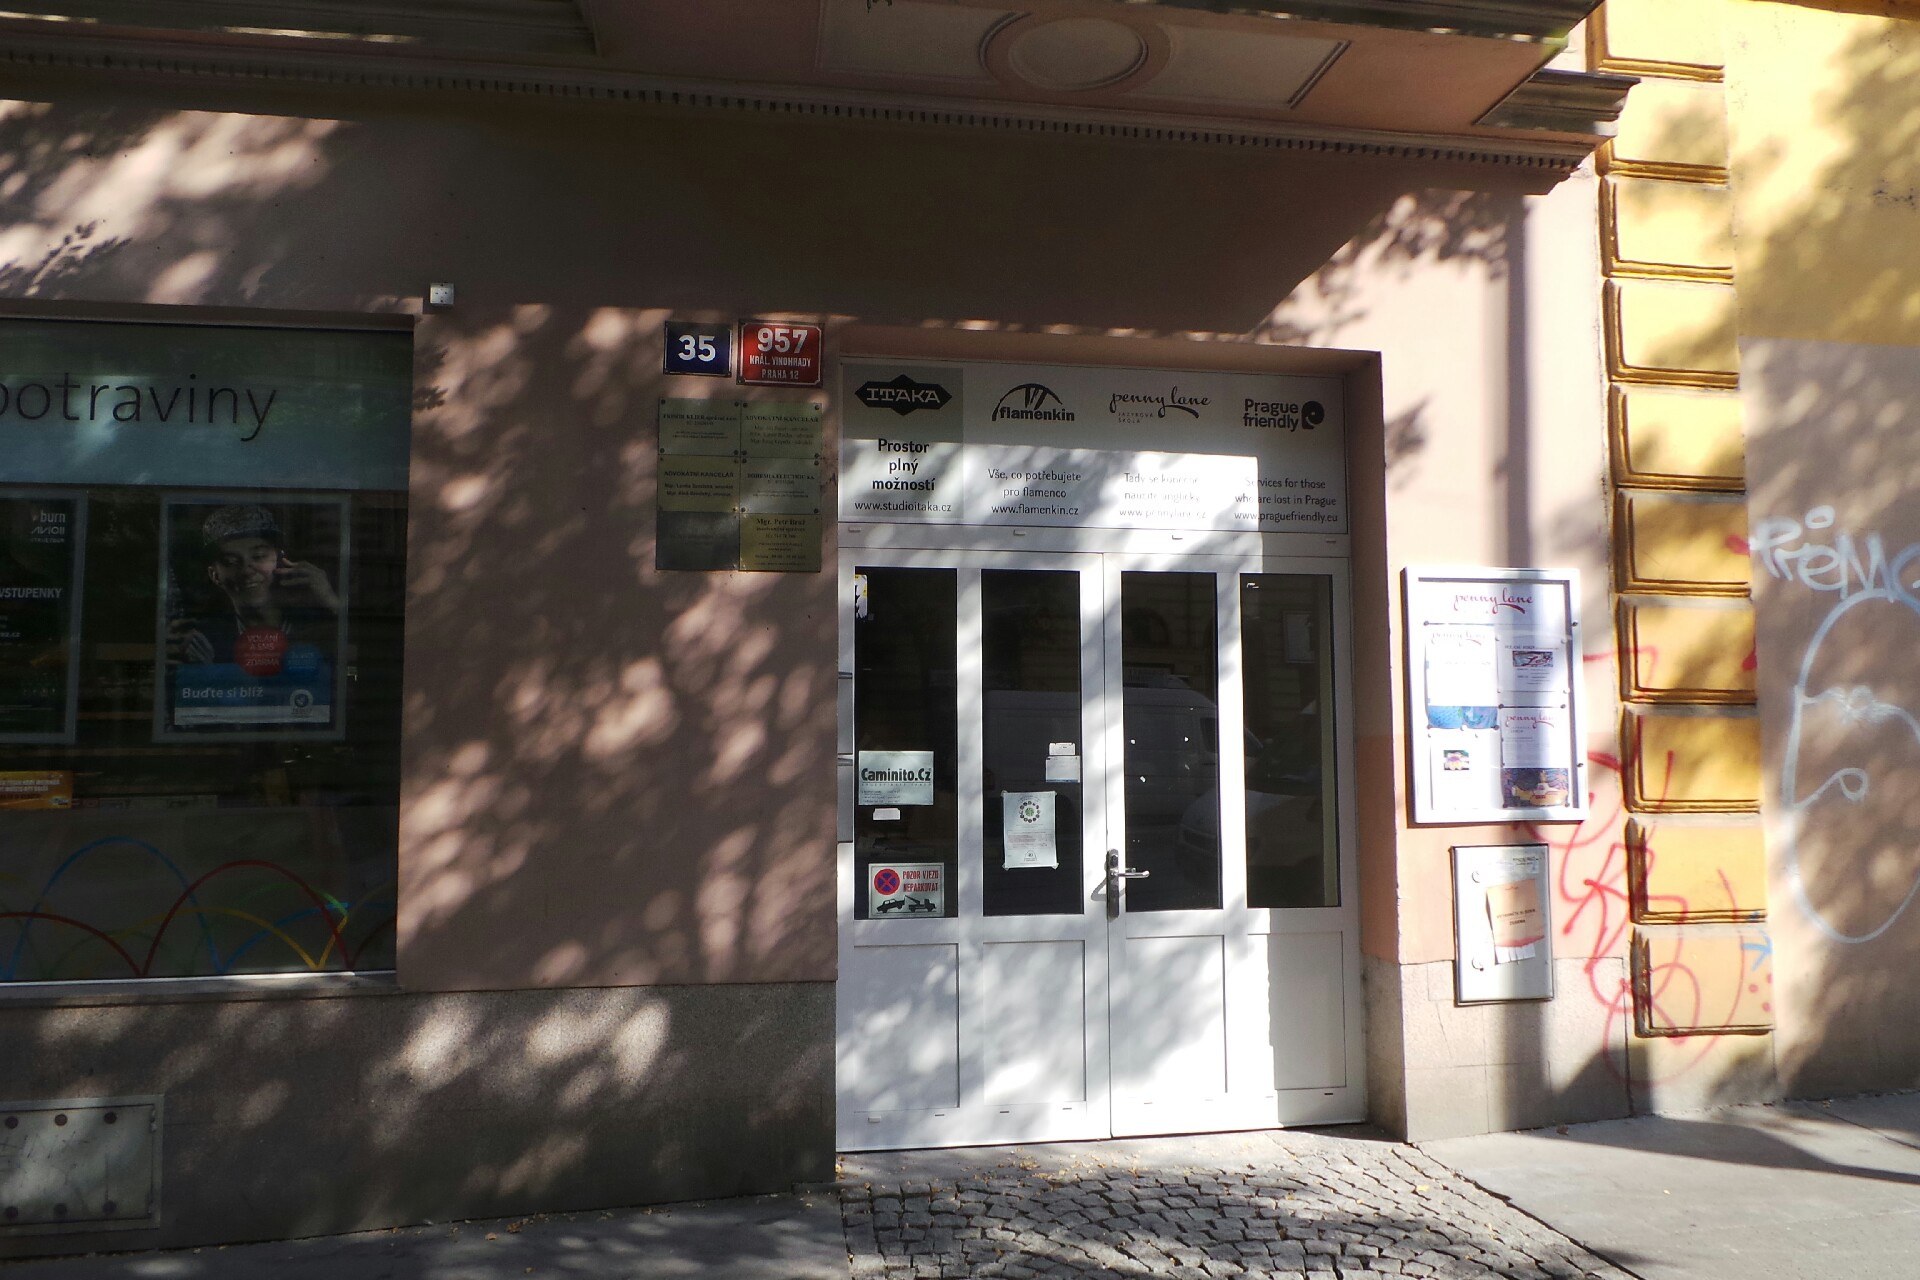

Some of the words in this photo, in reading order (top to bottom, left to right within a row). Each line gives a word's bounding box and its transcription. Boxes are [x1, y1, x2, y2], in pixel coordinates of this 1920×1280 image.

[757, 327, 808, 354] 957
[677, 334, 717, 363] 35
[749, 352, 770, 366] KRÁL.
[772, 355, 811, 368] VINOHRADY
[761, 368, 787, 379] PRAHA
[789, 370, 799, 380] 12
[866, 387, 941, 404] ITAKA
[1109, 392, 1166, 418] penny
[1171, 385, 1211, 406] lane
[0, 372, 277, 442] otraviny
[999, 406, 1075, 421] flamenkin
[1244, 398, 1299, 417] Prague
[1243, 412, 1299, 432] friendly
[878, 438, 930, 453] Prostor
[889, 457, 919, 475] plný
[872, 476, 936, 491] možností
[987, 468, 1008, 480] Vše,
[1011, 471, 1022, 480] co
[1025, 470, 1082, 484] potřebujete
[1124, 472, 1145, 486] Tady
[1245, 476, 1283, 488] Services
[1284, 477, 1298, 488] for
[1300, 478, 1326, 489] those
[1003, 488, 1020, 499] pro
[1023, 486, 1067, 498] flamenco
[1234, 492, 1254, 503] who
[1258, 496, 1271, 504] are
[1274, 494, 1290, 505] lost
[1293, 495, 1303, 505] in
[1305, 494, 1337, 508] Prague
[854, 500, 952, 512] www.studioitaka.cz
[991, 503, 1079, 516] www.flamenkin.cz
[40, 508, 66, 523] burn
[1234, 510, 1338, 524] www.praguefriendly.eu
[1453, 594, 1499, 615] penny
[1502, 586, 1534, 605] lane
[181, 686, 224, 699] Buďte
[226, 686, 237, 699] si
[239, 686, 264, 698] blíž
[860, 767, 932, 782] Caminito.Cz
[902, 870, 921, 880] POZOR
[922, 870, 939, 879] VJEZD
[903, 882, 939, 893] NEPARKOVAT
